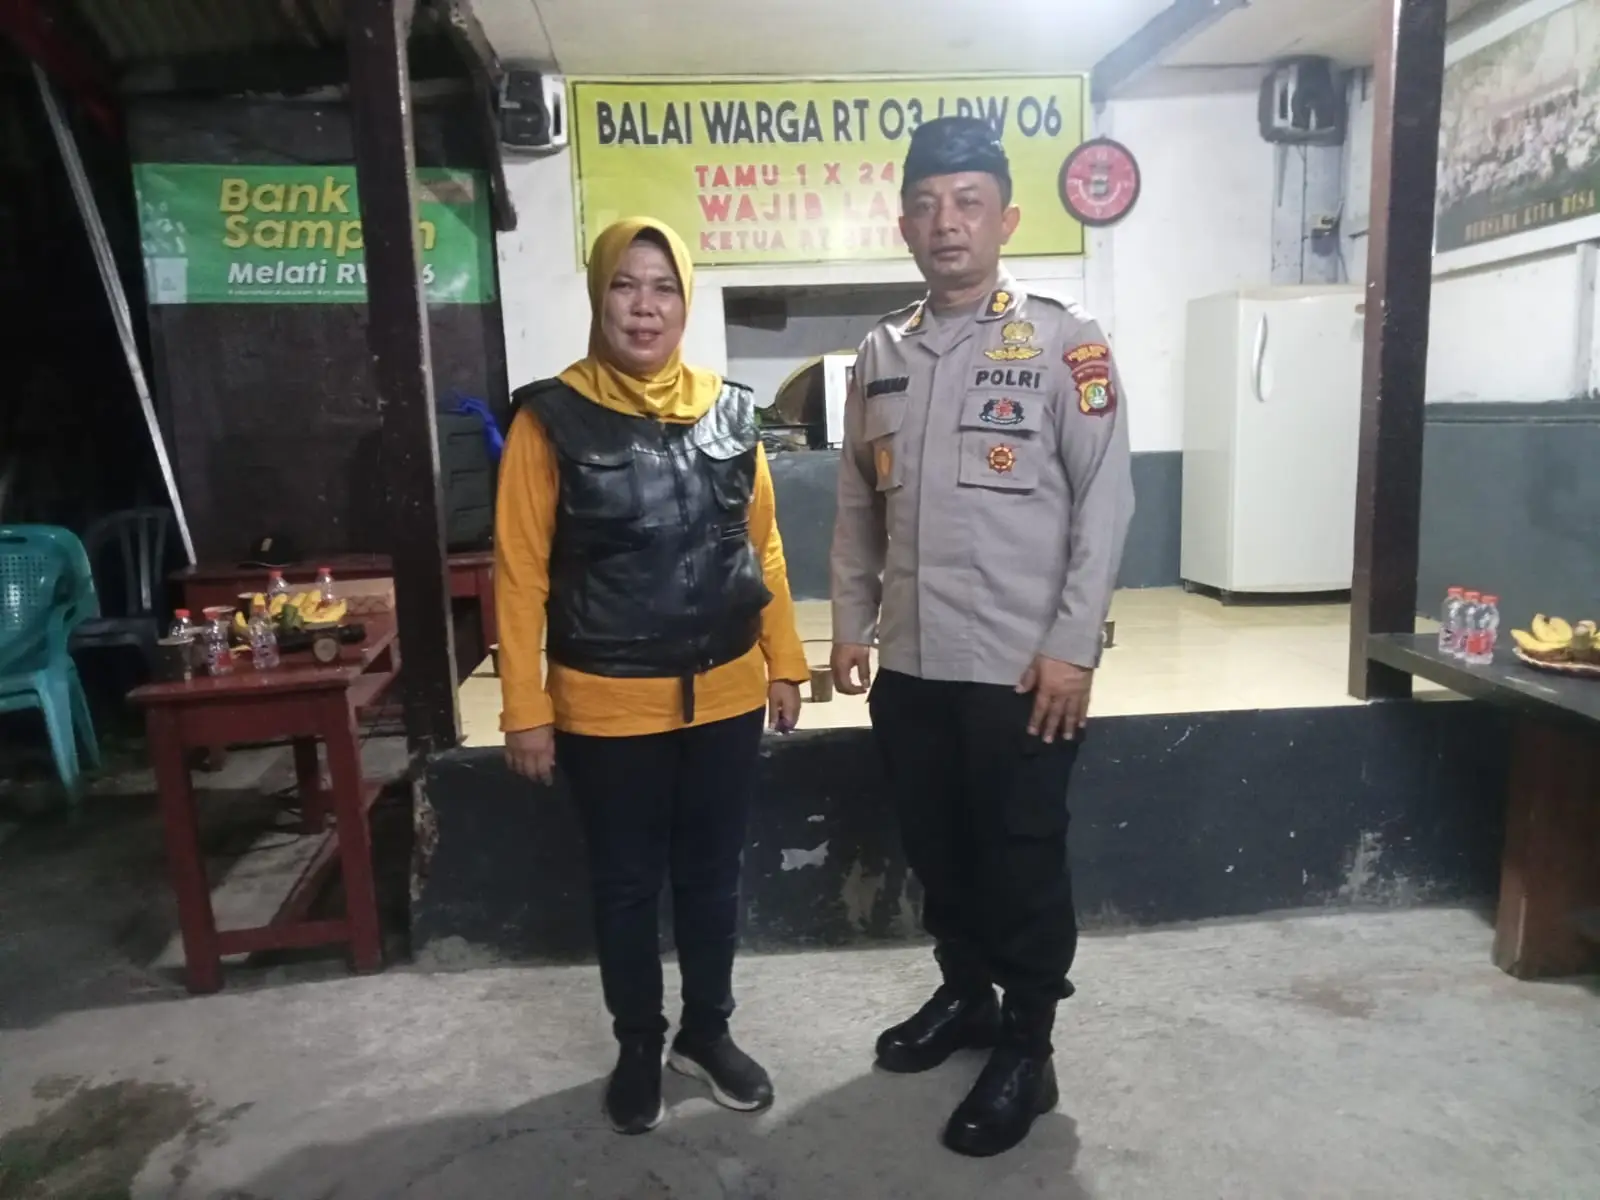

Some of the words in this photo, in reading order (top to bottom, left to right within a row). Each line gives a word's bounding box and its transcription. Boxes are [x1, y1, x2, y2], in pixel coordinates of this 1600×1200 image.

[596, 100, 692, 144] BALAI
[700, 99, 824, 144] WARGA
[832, 98, 870, 142] RT
[1017, 95, 1062, 137] 06
[695, 163, 779, 188] TAMU
[796, 163, 807, 186] 1
[823, 162, 842, 185] X
[858, 161, 895, 185] 24
[220, 176, 350, 213] Bank
[697, 192, 823, 222] WAJIB
[700, 229, 786, 251] KETUA
[228, 259, 328, 284] Melati
[975, 370, 1041, 389] POLRI
